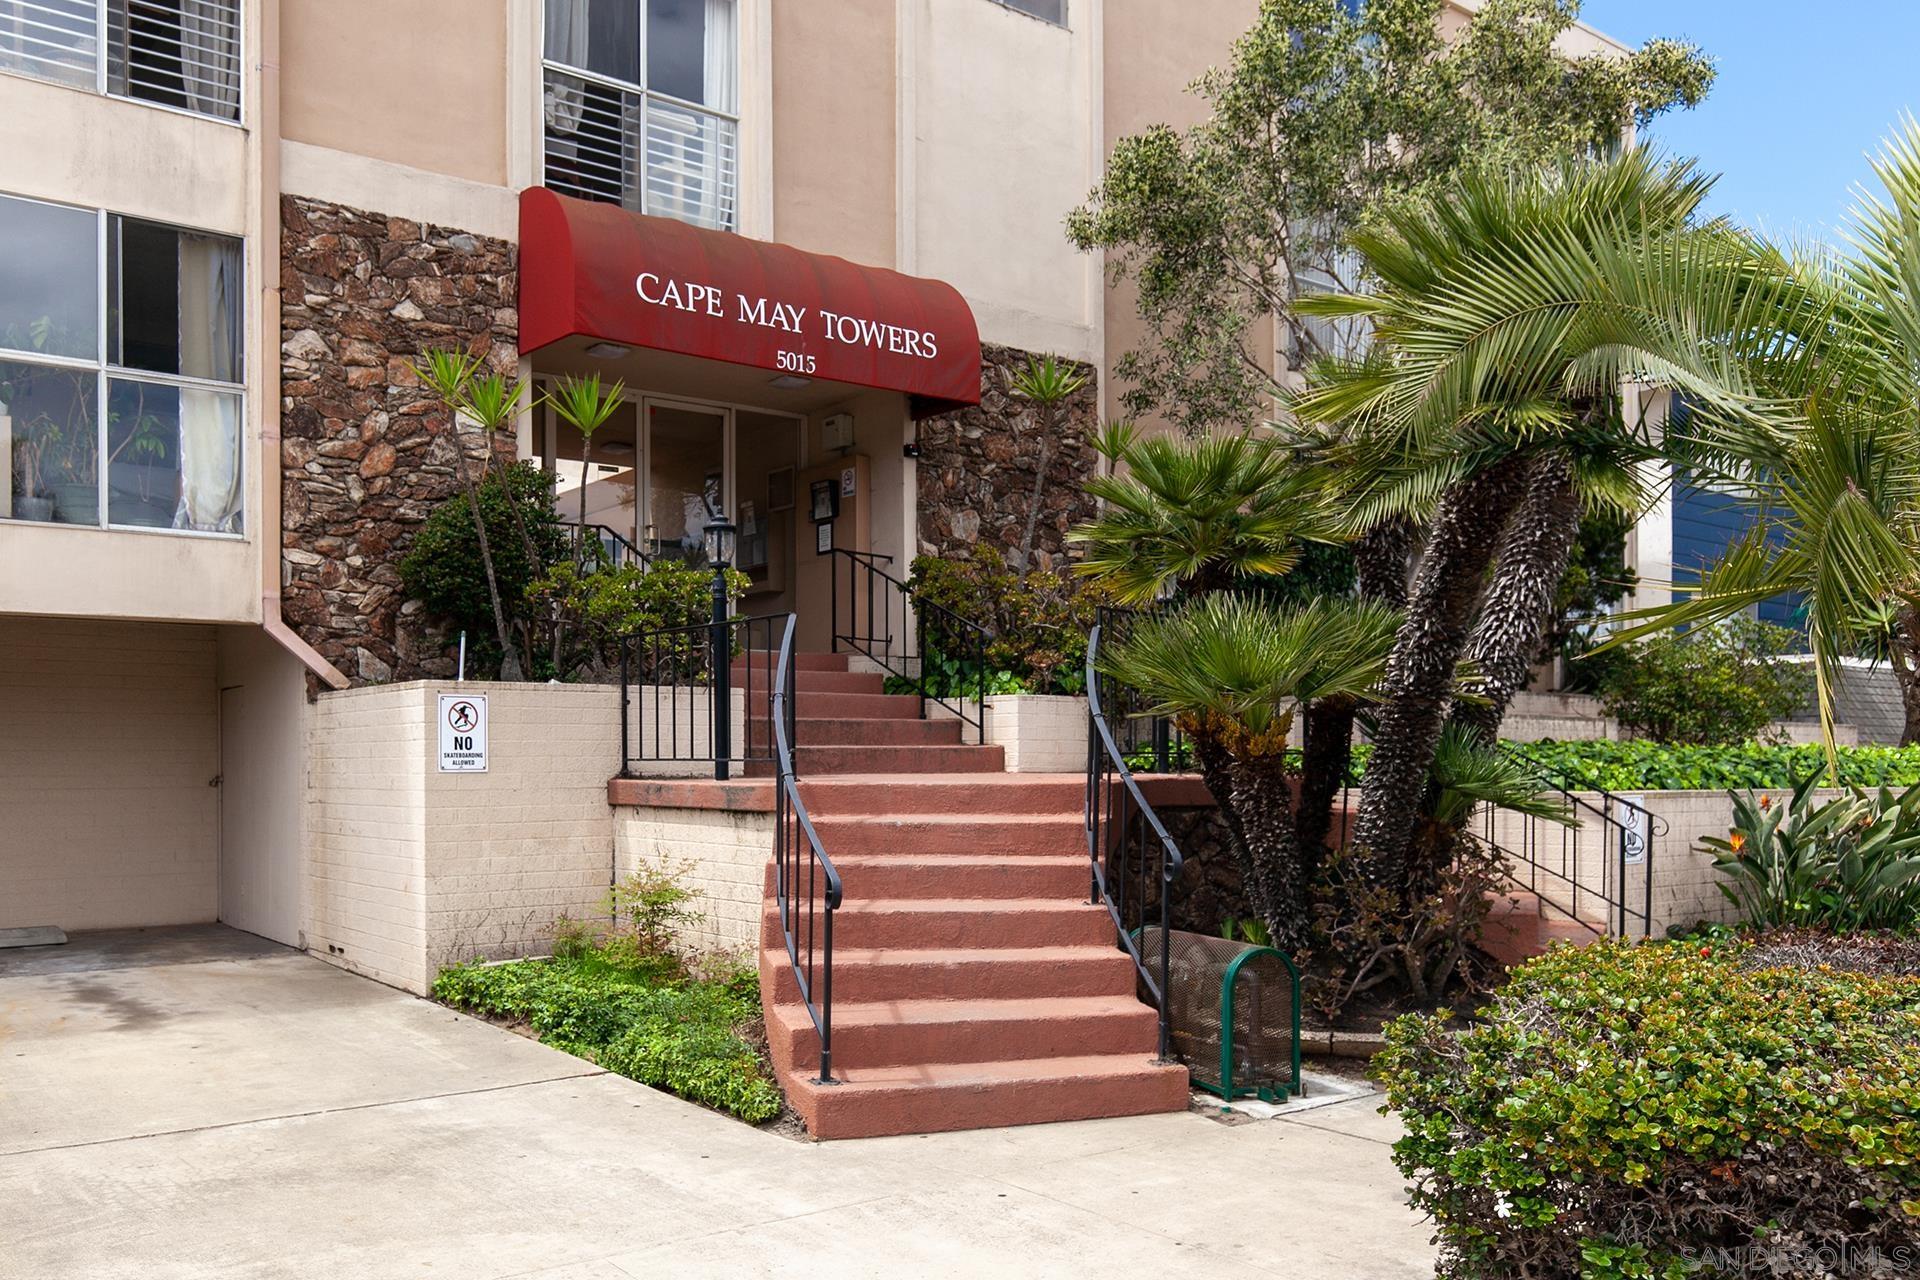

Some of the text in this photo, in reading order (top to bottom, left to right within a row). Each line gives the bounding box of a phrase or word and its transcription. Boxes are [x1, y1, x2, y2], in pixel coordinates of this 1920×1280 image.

[635, 272, 938, 359] CAPE MAY TOWERS
[776, 350, 816, 374] 5015
[454, 736, 472, 750] NO
